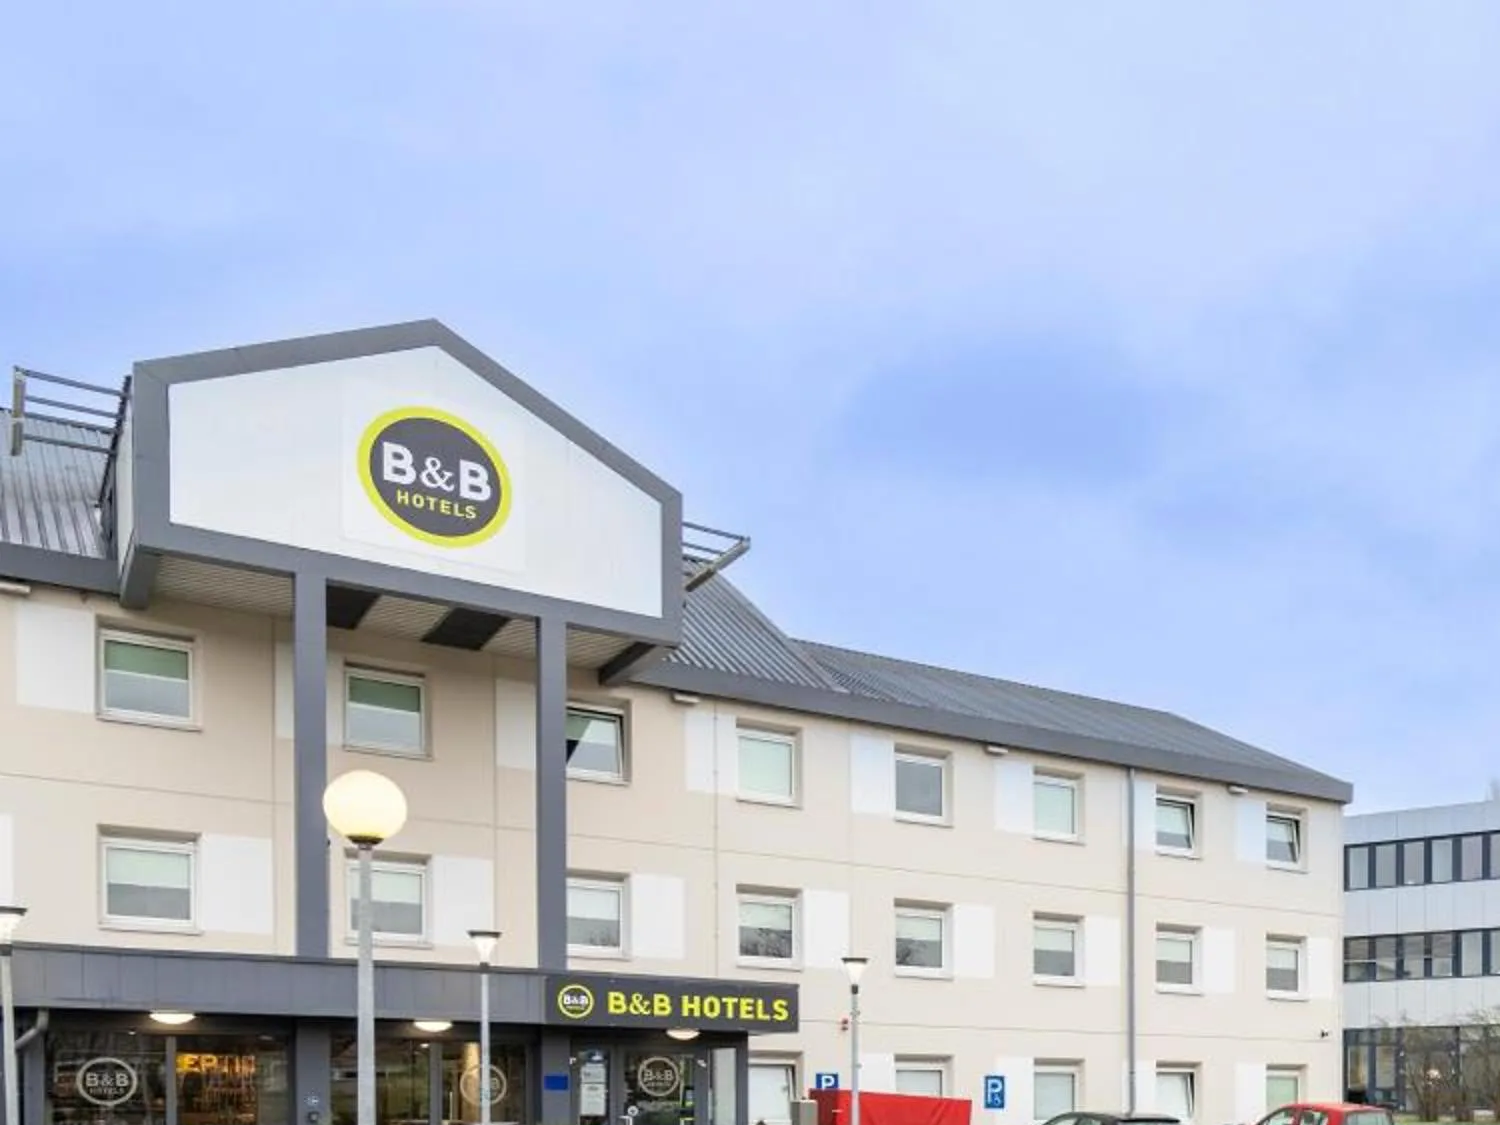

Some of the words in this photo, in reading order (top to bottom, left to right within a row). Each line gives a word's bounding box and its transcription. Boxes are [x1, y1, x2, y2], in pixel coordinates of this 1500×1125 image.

[382, 441, 492, 502] B&B
[396, 489, 477, 519] HOTELS
[608, 991, 672, 1017] B&B
[681, 994, 789, 1021] HOTELS
[86, 1072, 129, 1087] B&B
